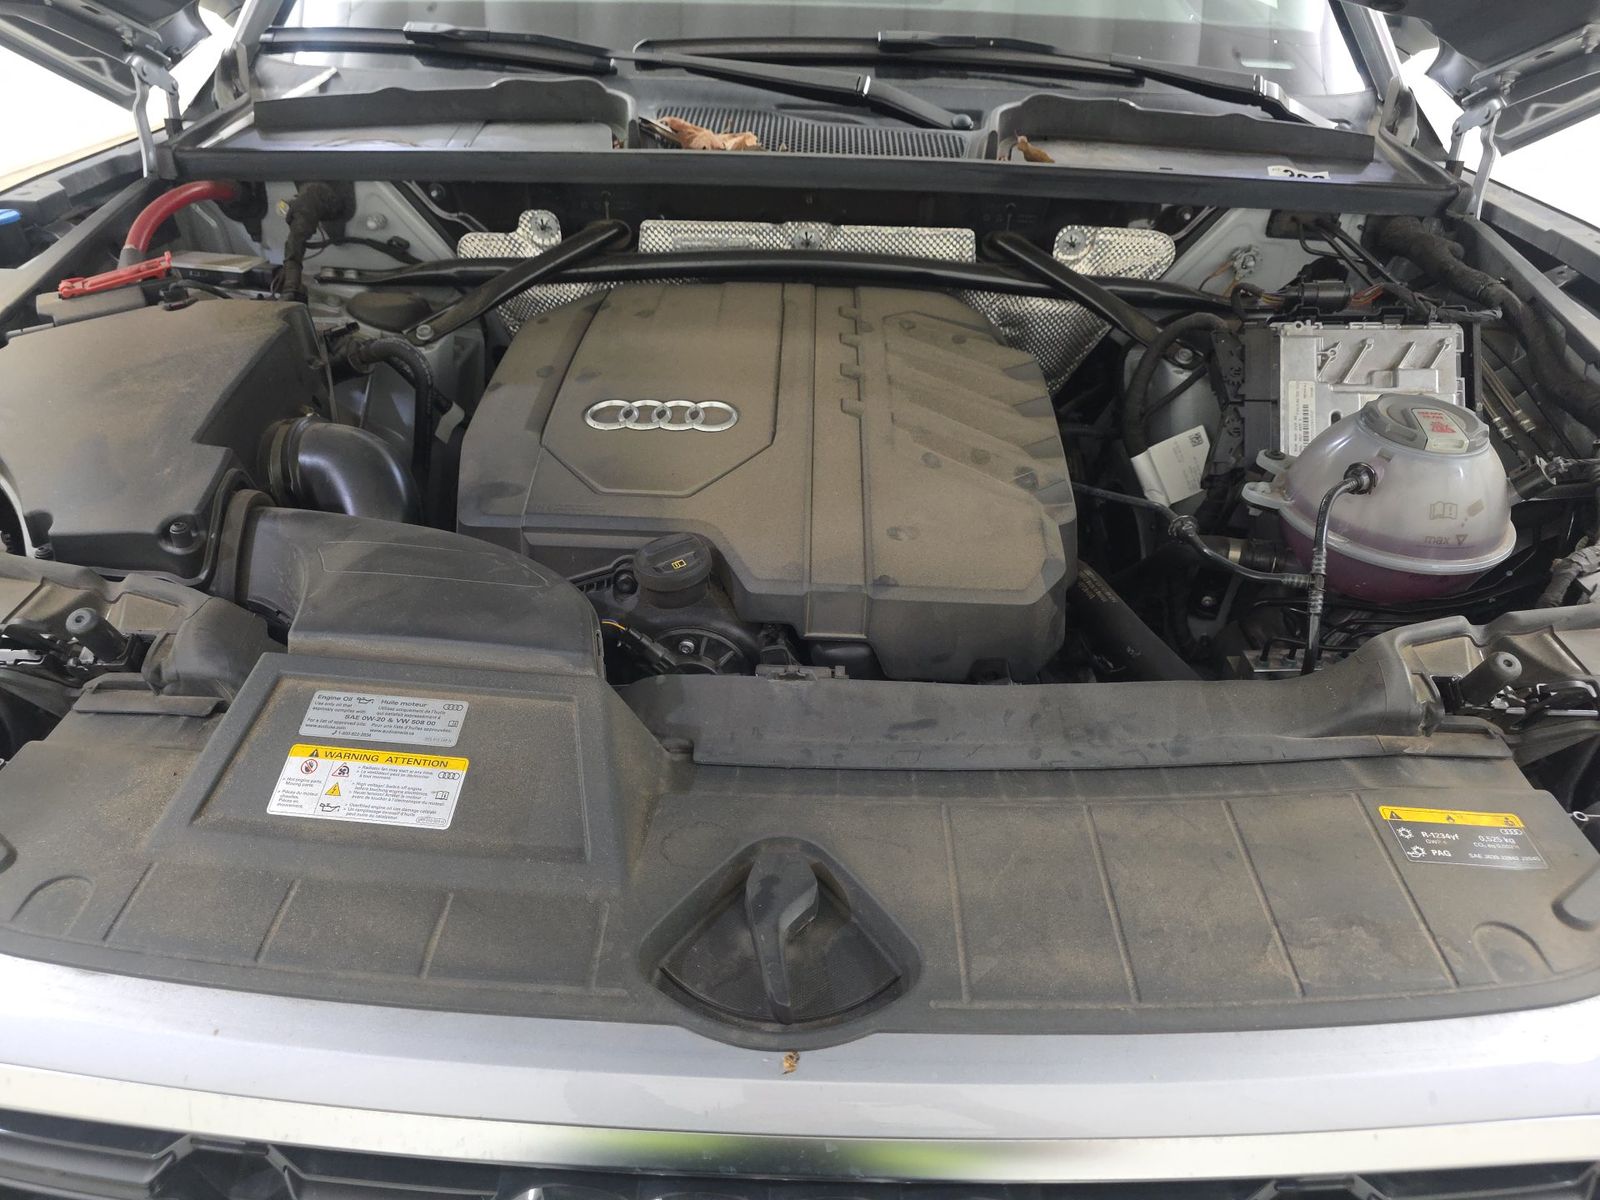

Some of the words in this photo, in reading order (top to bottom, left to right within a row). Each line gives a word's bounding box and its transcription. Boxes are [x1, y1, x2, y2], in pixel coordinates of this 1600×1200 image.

[1424, 535, 1450, 545] max
[324, 750, 379, 762] WARNING
[385, 756, 449, 768] ATTENTION
[1421, 831, 1460, 840] R-1234yf
[1503, 836, 1516, 844] kg
[1430, 849, 1452, 857] PAG
